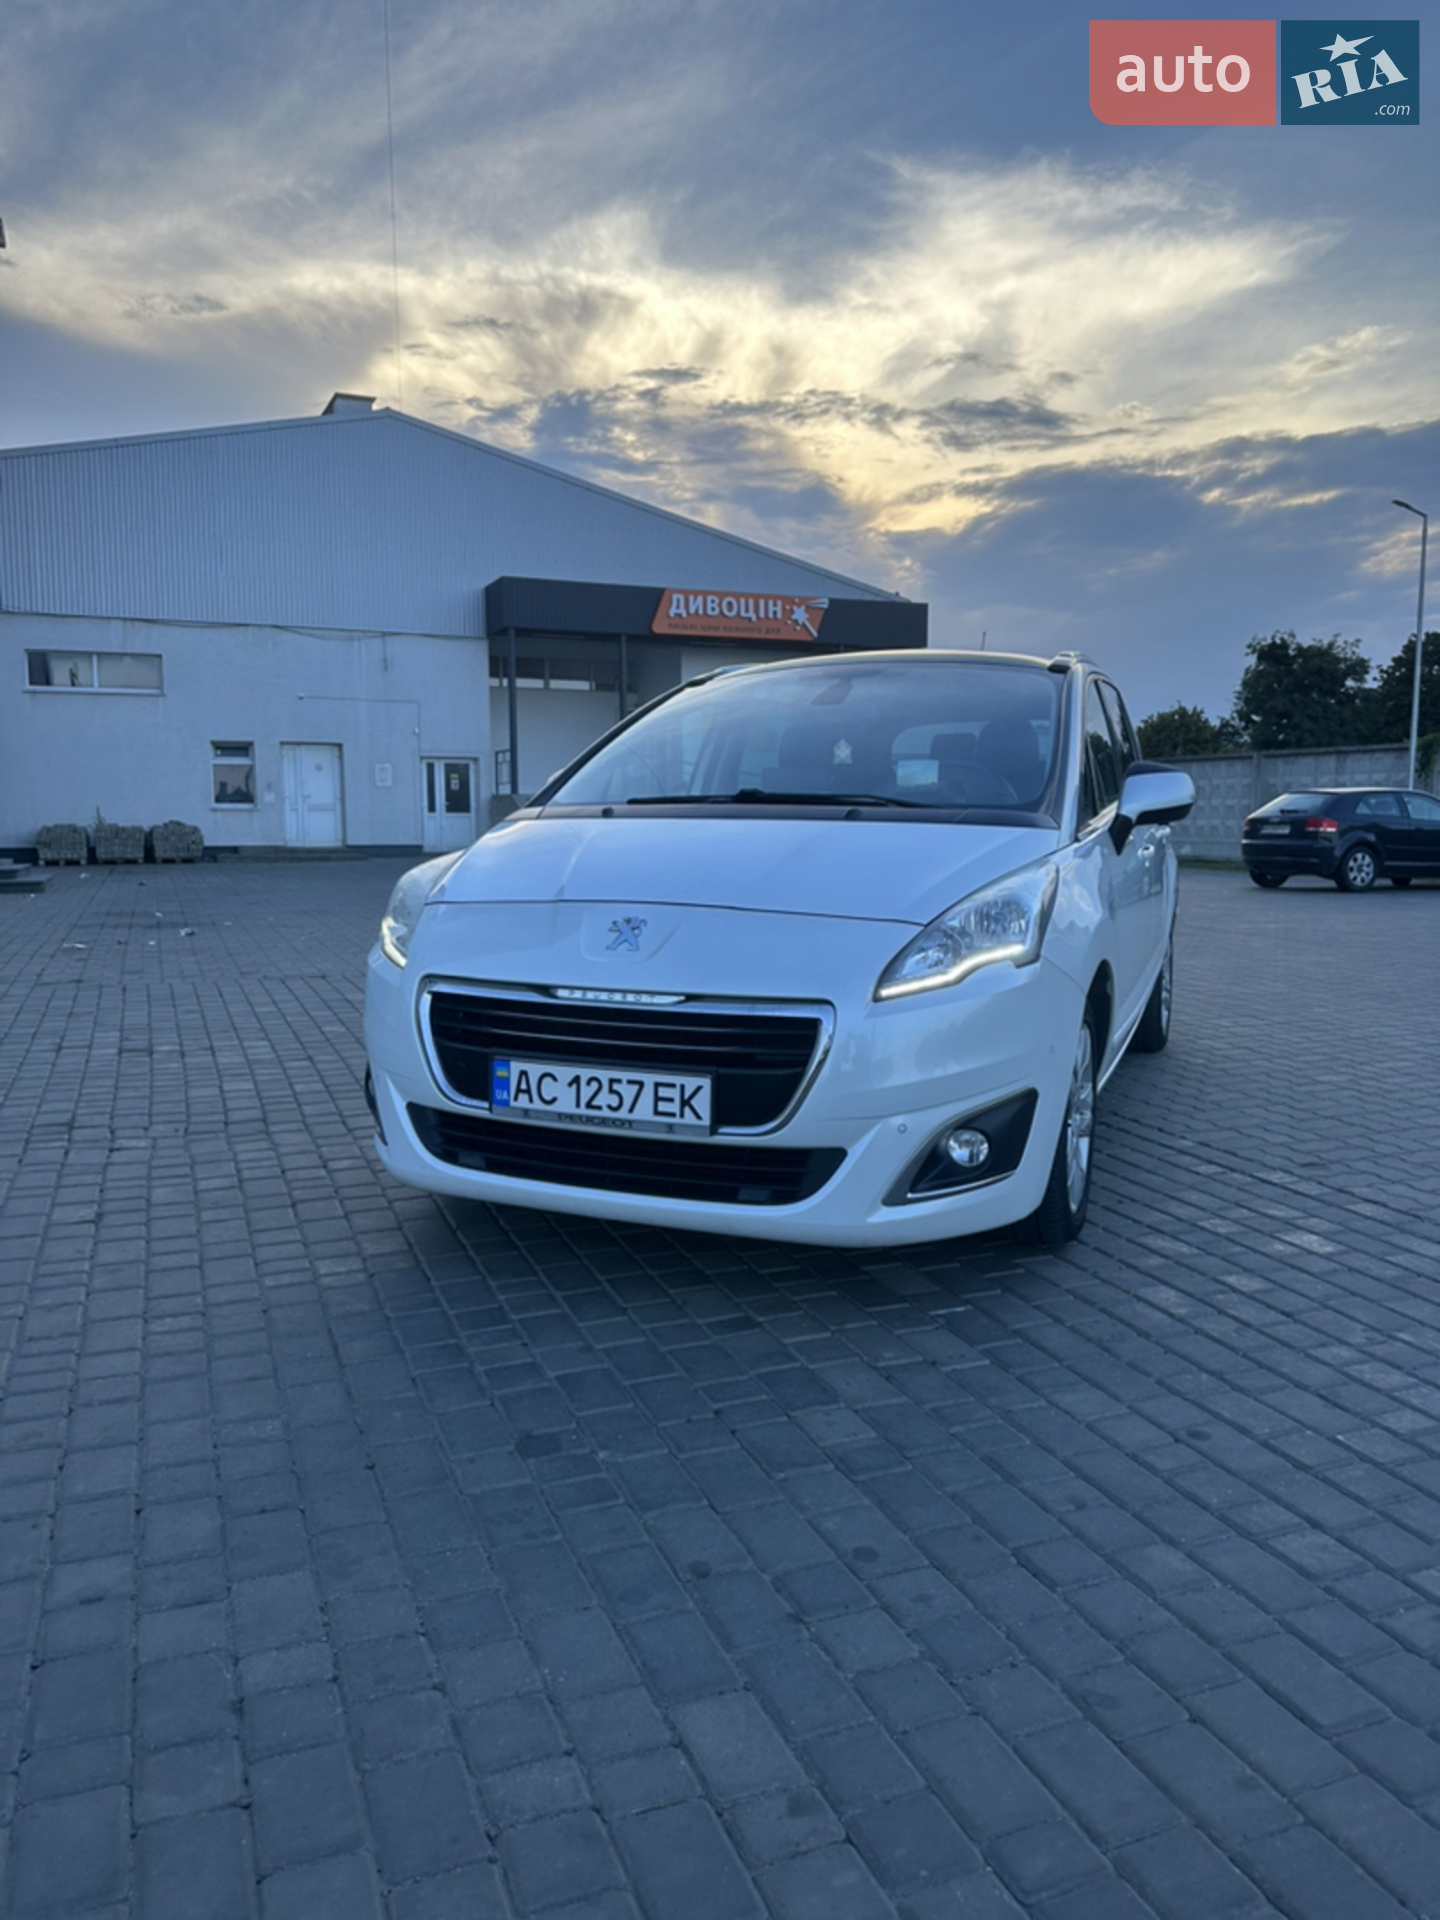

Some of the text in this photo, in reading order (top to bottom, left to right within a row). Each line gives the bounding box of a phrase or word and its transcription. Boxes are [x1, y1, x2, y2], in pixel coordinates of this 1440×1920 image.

[668, 593, 783, 622] ДИВОЦІН
[495, 1089, 509, 1101] UA
[513, 1069, 704, 1121] AC 1257 EK
[557, 1112, 636, 1129] PEUGEOT
